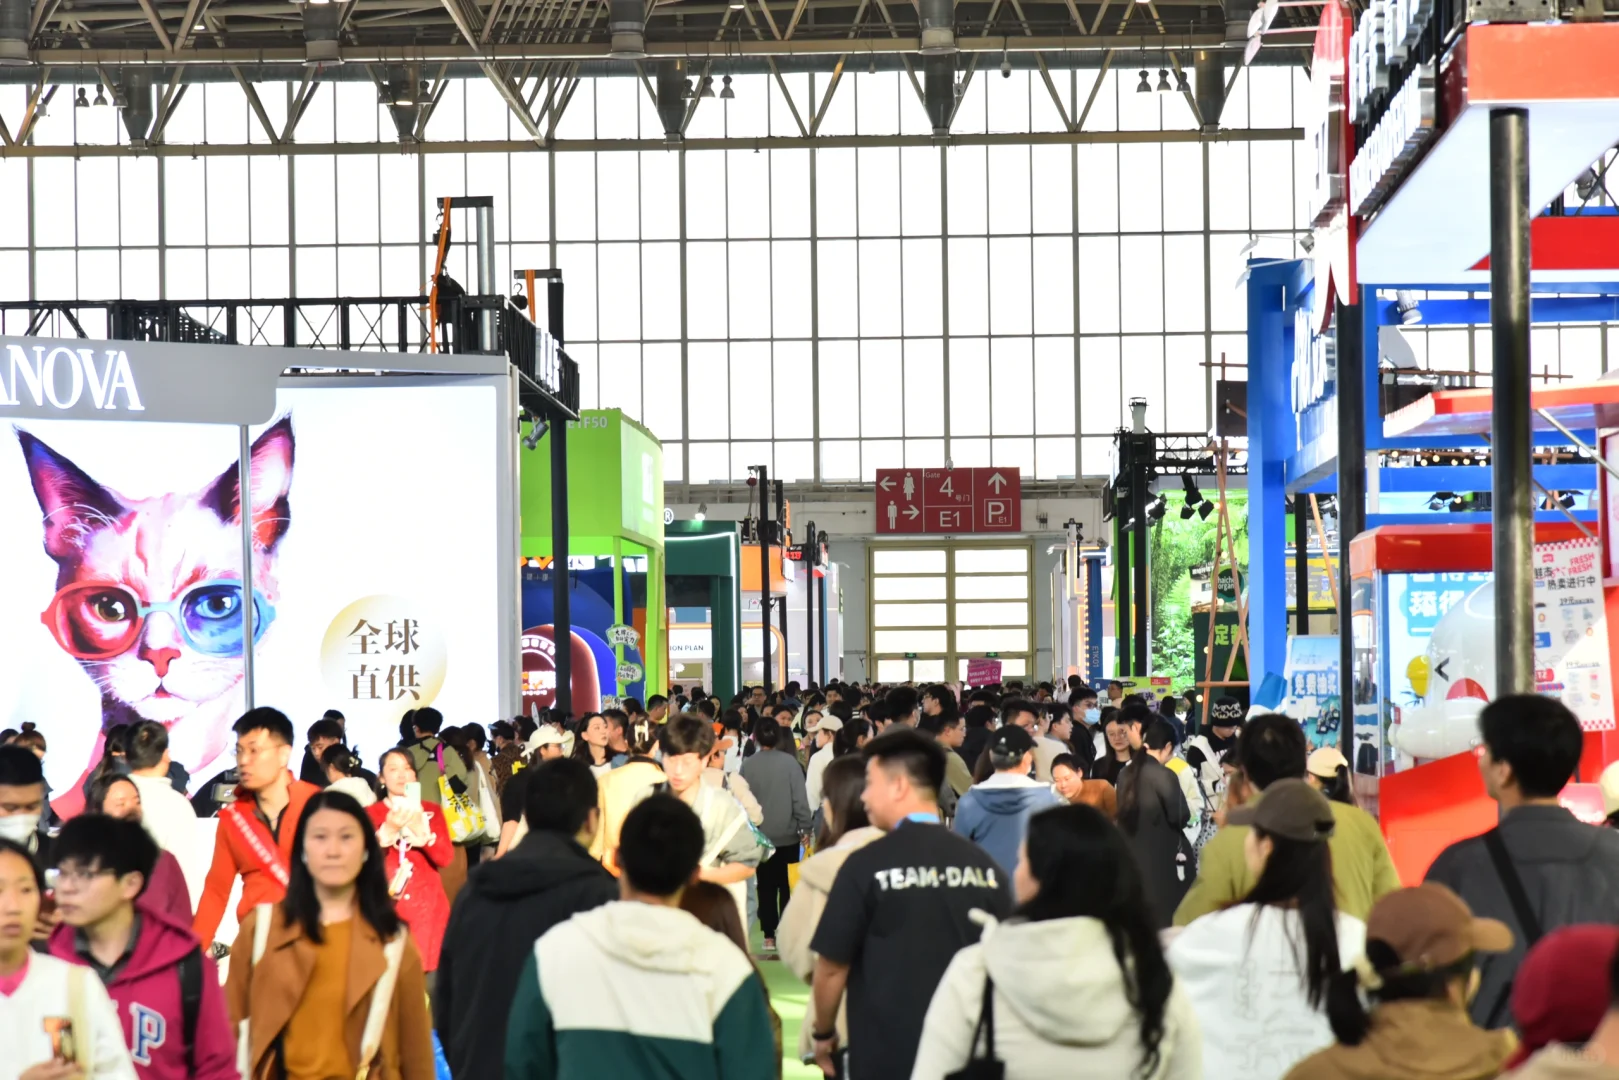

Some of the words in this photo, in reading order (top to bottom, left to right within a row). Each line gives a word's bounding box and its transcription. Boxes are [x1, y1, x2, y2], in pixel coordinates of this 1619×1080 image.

[0, 345, 145, 411] NOVA
[939, 476, 954, 498] 4
[955, 494, 970, 502] 号门
[940, 511, 960, 527] E1
[988, 501, 1004, 523] P
[998, 516, 1007, 524] E1
[1568, 562, 1593, 575] FRESH
[1570, 552, 1595, 566] FRESH
[1547, 575, 1596, 591] 热卖进行中
[345, 618, 421, 655] 全球
[1091, 645, 1099, 668] E1K01
[346, 664, 421, 701] 直供
[128, 1001, 166, 1067] P
